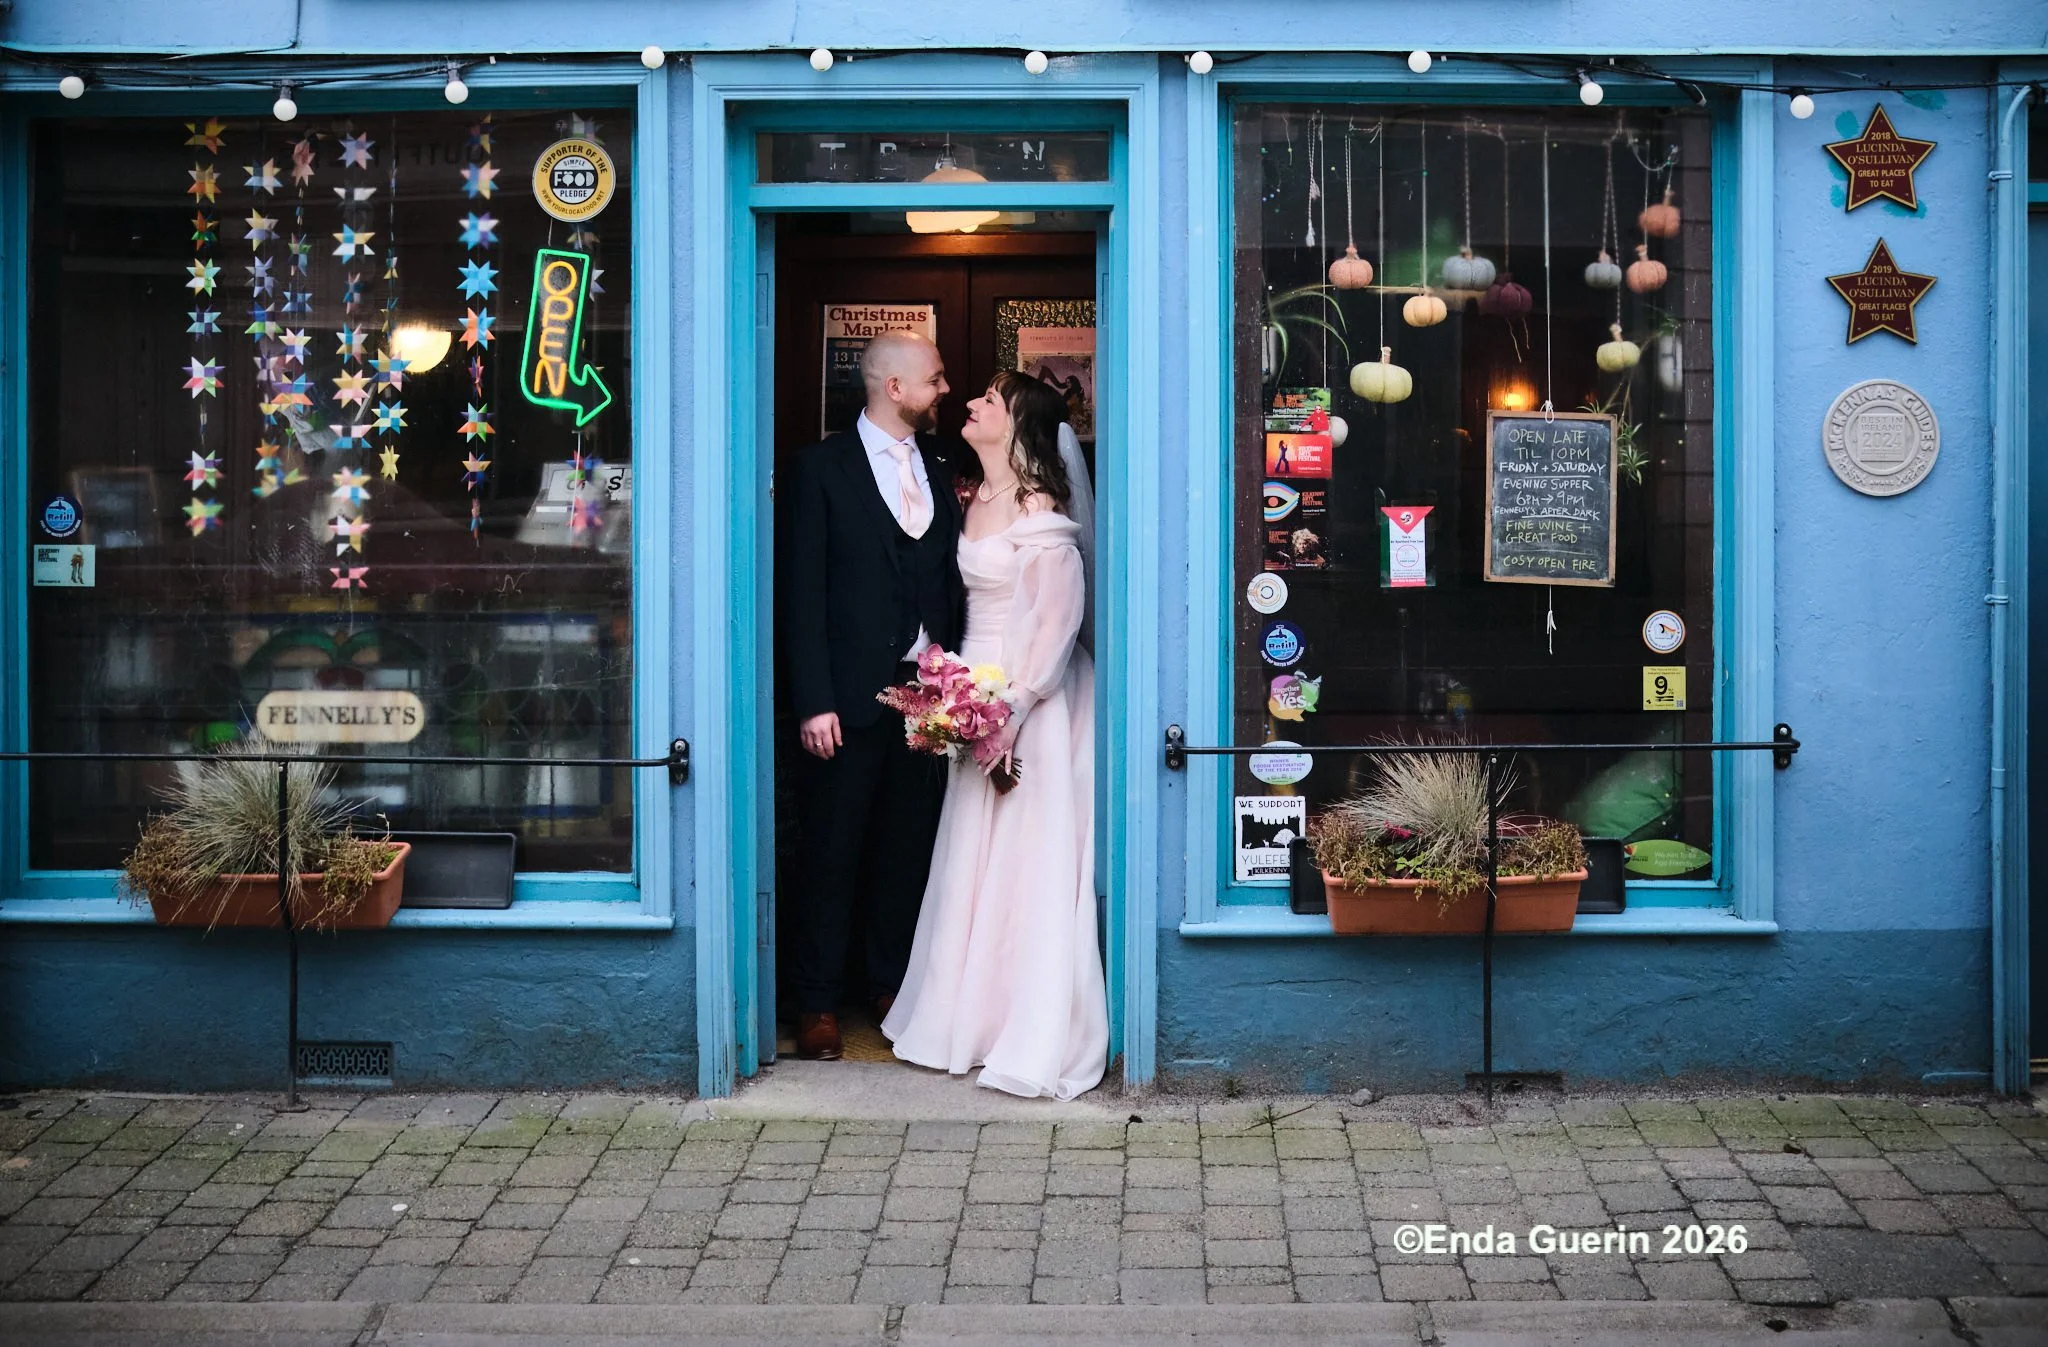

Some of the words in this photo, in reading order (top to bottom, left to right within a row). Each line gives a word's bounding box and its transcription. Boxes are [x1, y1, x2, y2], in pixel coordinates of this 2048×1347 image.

[1871, 132, 1891, 140] 2018
[1856, 144, 1906, 152] LUCINDA
[540, 145, 584, 174] SUPPORTER
[586, 148, 597, 158] OF
[596, 157, 608, 174] THE
[1848, 154, 1916, 164] O'SULLIVAN
[1857, 277, 1907, 286] LUCINDA
[1849, 289, 1916, 297] O'SULLIVAN
[830, 307, 926, 321] Christmas
[534, 260, 578, 396] OPEN
[843, 323, 912, 336] Markt
[834, 352, 848, 362] 13
[1902, 394, 1934, 452] GUIDES
[1508, 429, 1545, 443] OPEN
[1553, 430, 1587, 444] LATE
[1862, 432, 1902, 448] 2024
[1514, 448, 1542, 460] TIL
[1551, 447, 1590, 460] 10PM
[1500, 462, 1539, 472] FRIDAY
[1552, 462, 1606, 476] SATURDAY
[1503, 478, 1547, 489] EVENING
[1551, 478, 1594, 491] SUPPER
[1516, 491, 1540, 506] 6PM
[1557, 490, 1584, 506] 9PM
[47, 512, 73, 520] Refill
[1540, 507, 1571, 516] AFTER
[1573, 507, 1600, 520] DARK
[1506, 520, 1534, 531] FINE
[1538, 521, 1574, 532] WINE
[1579, 523, 1591, 533] +
[1506, 532, 1546, 543] GREAT
[1551, 534, 1577, 543] FOOD
[1503, 555, 1535, 568] COSY
[1538, 556, 1565, 569] OPEN
[1572, 559, 1596, 570] FIRE
[1269, 640, 1294, 649] Refill
[1273, 686, 1300, 694] Together
[1655, 676, 1668, 695] 9
[268, 706, 416, 725] FENNELLY'S
[1239, 800, 1253, 808] WE
[1258, 800, 1302, 808] SUPPORT
